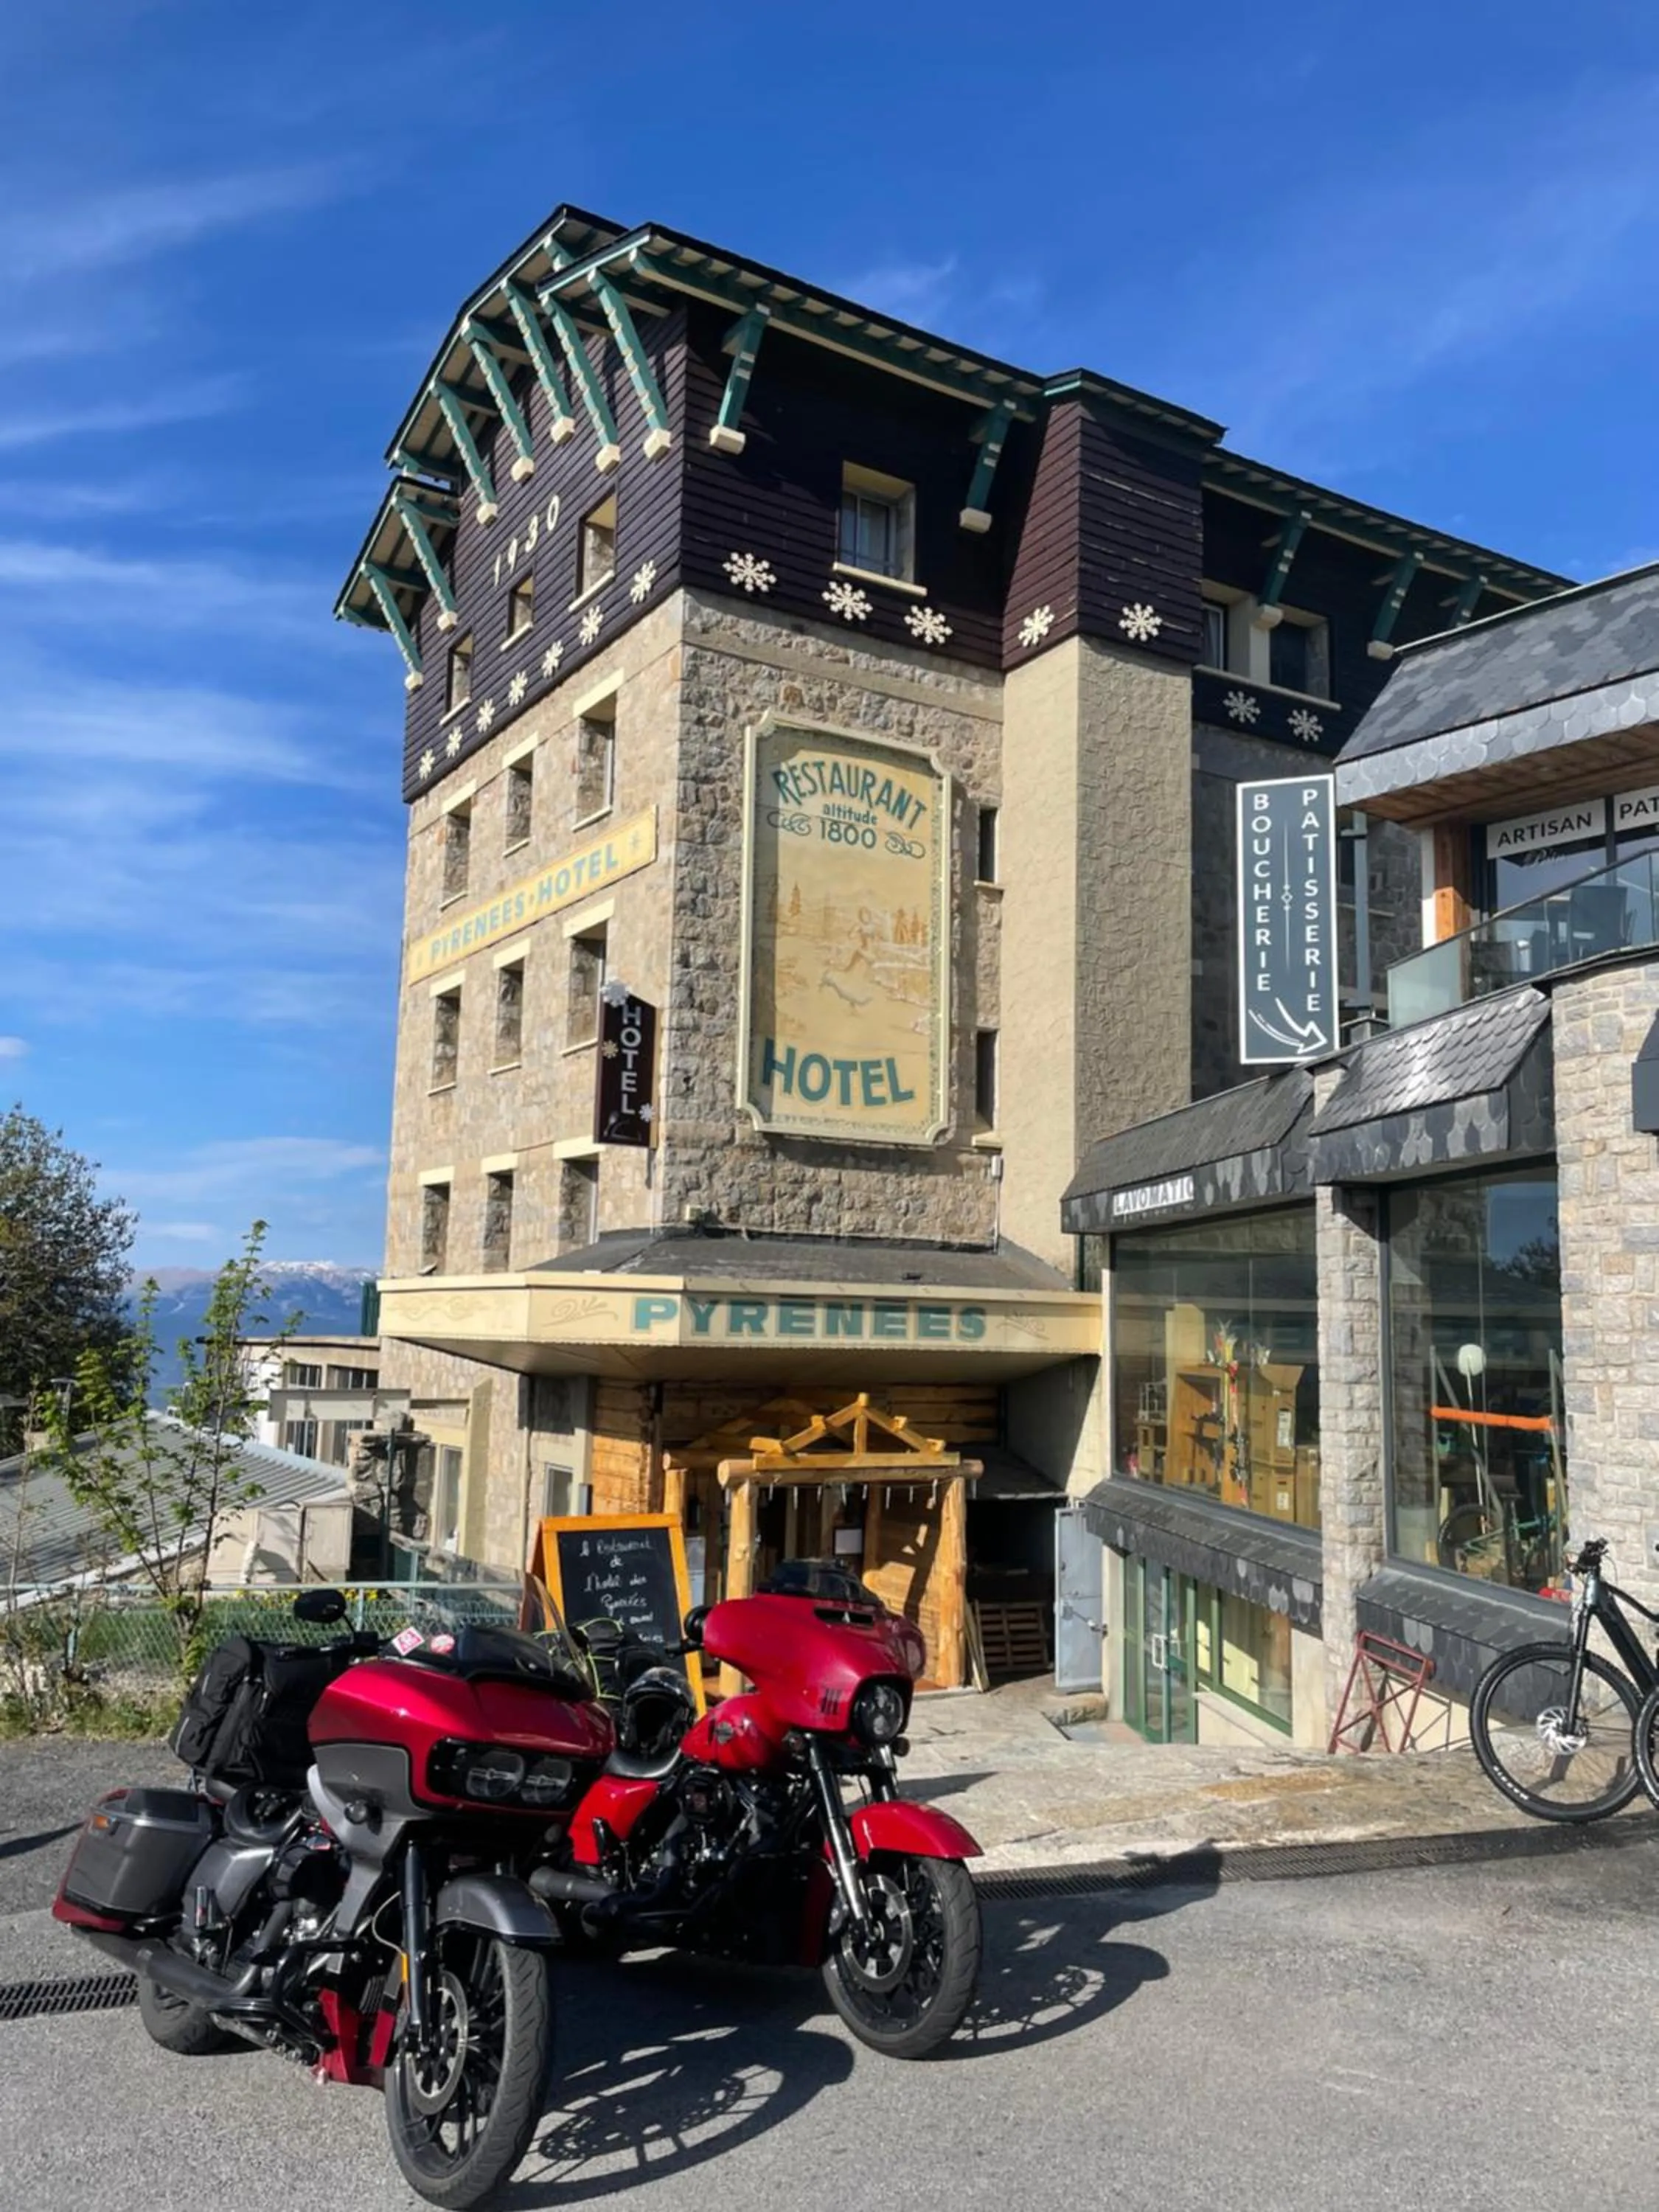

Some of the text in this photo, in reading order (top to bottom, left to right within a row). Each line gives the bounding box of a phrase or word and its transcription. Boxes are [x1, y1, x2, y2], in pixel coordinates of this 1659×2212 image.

[493, 495, 560, 587] 1930
[773, 759, 928, 830] RESTAURANT
[822, 802, 878, 827] altitude
[1497, 796, 1659, 847] ARTISAN PAT
[820, 820, 877, 850] 1800
[534, 842, 619, 906] HOTEL
[1251, 793, 1272, 992] BOUCHERIE
[1301, 788, 1321, 1012] PATISSERIE
[620, 1005, 641, 1116] HOTEL
[762, 1037, 914, 1107] HOTEL
[632, 1296, 986, 1338] PYRENEES
